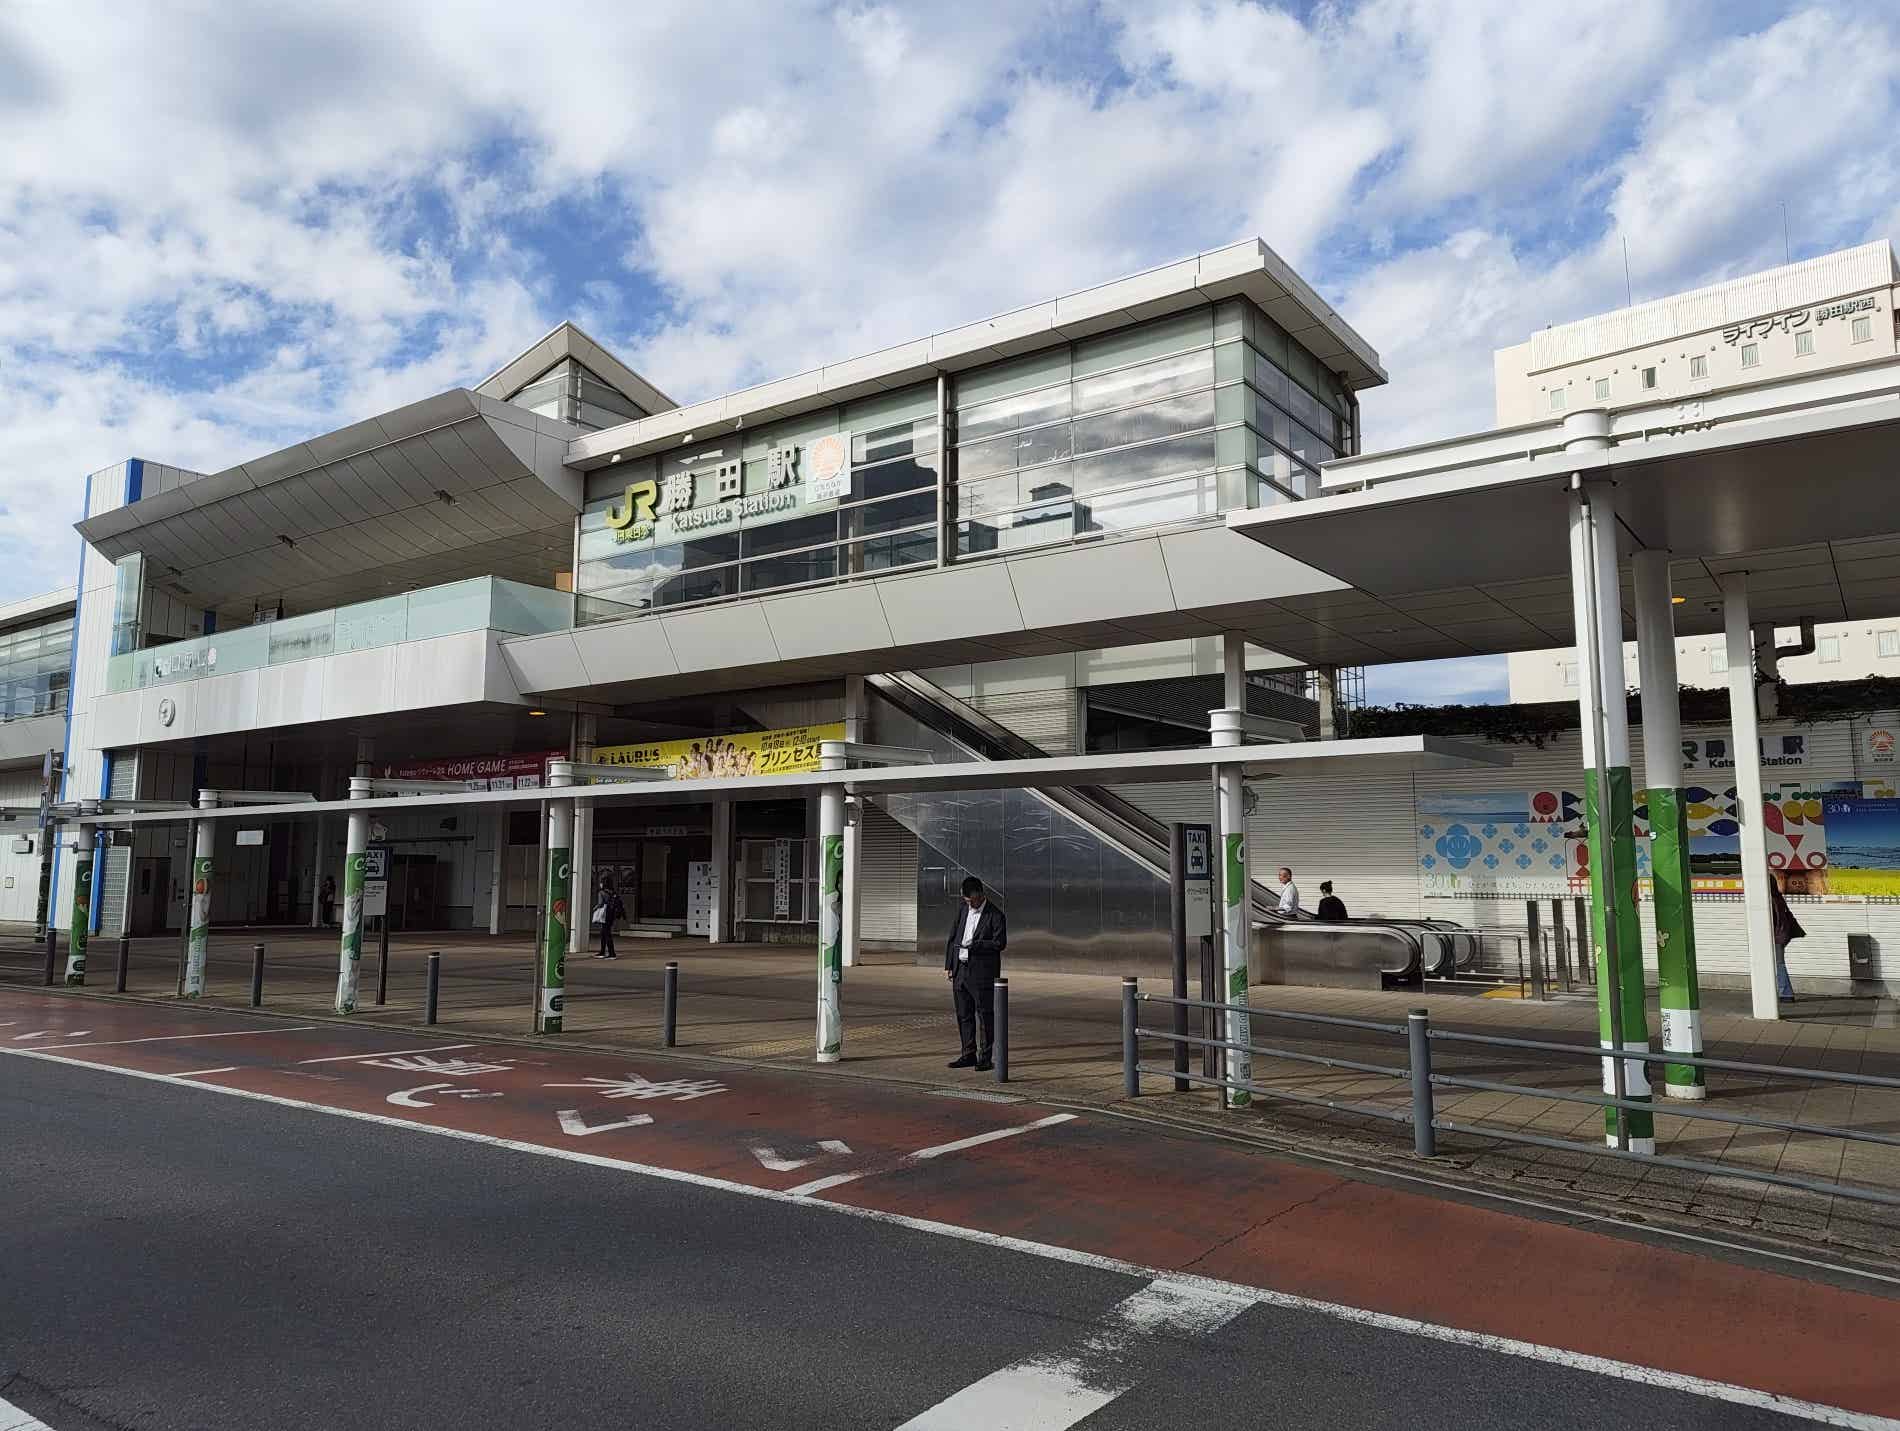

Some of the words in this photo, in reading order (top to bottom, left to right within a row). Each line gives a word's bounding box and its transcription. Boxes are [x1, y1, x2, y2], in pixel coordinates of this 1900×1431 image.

[604, 479, 657, 530] JR
[657, 443, 797, 513] 勝田駅
[671, 501, 730, 535] Katsuta
[733, 489, 794, 517] Station
[610, 748, 660, 765] LAURUS
[1760, 755, 1803, 767] Station
[447, 761, 475, 776] HOME
[477, 759, 506, 774] GAME
[1187, 831, 1205, 844] TAXI
